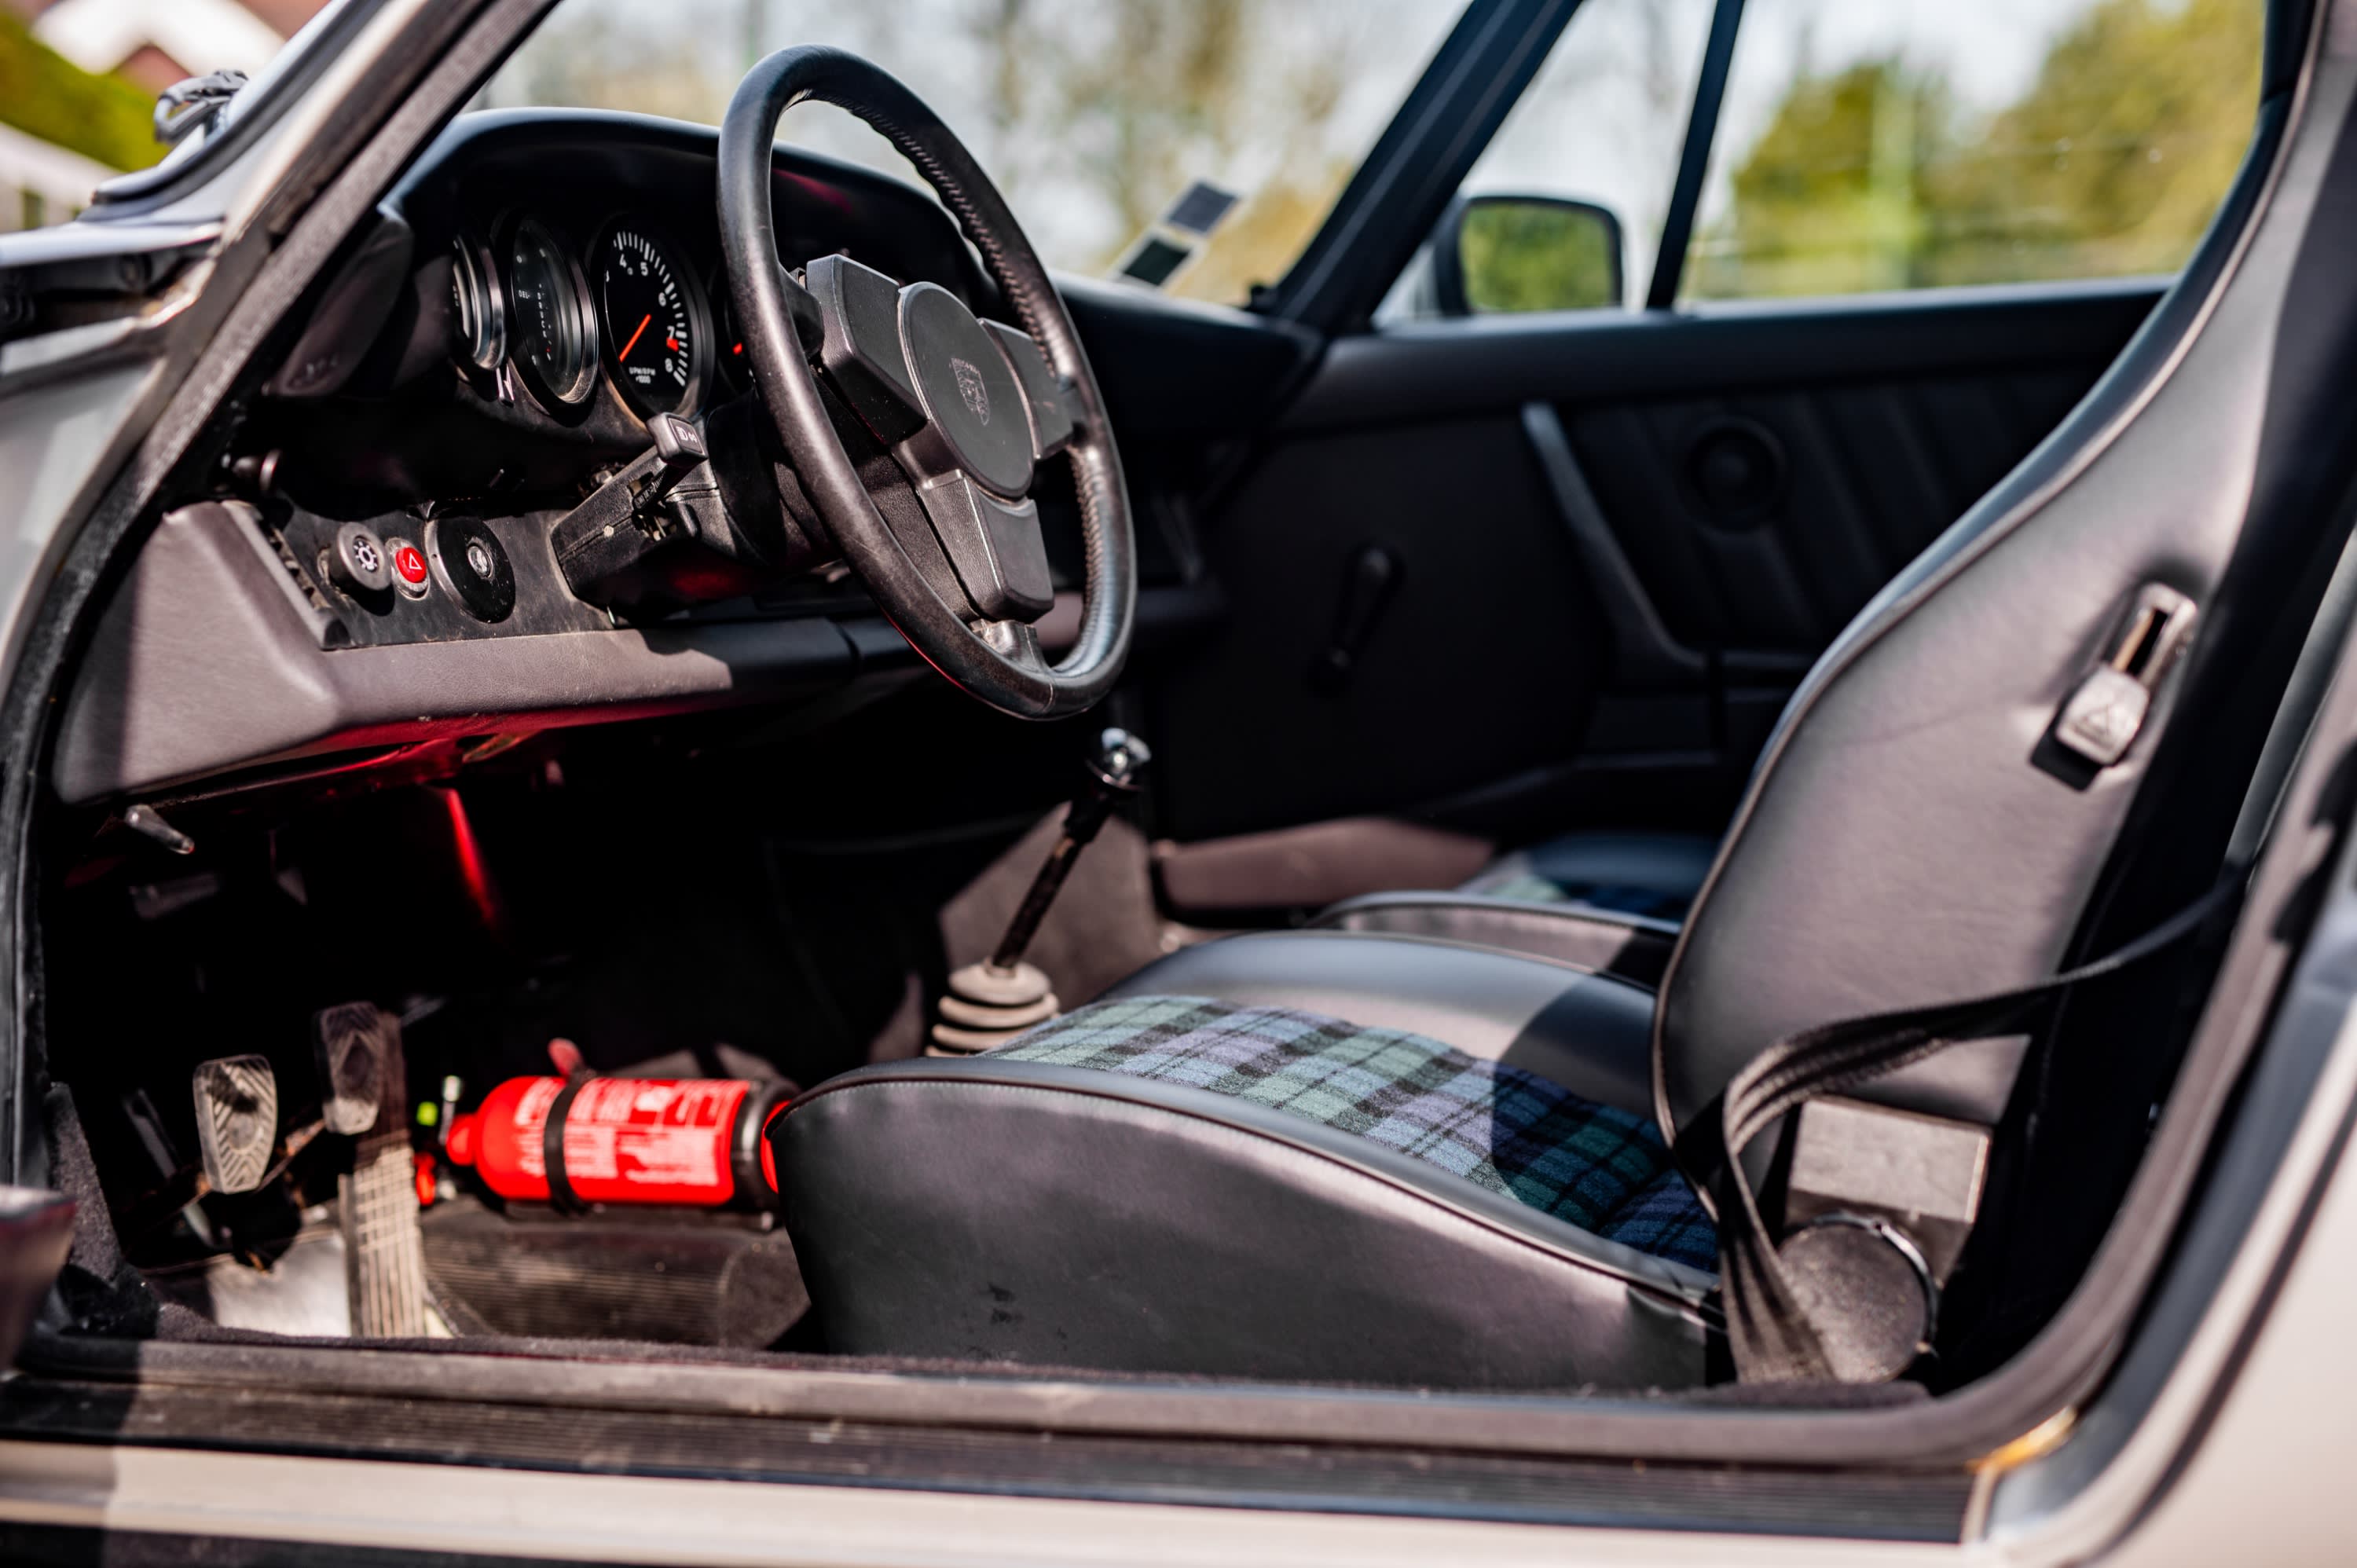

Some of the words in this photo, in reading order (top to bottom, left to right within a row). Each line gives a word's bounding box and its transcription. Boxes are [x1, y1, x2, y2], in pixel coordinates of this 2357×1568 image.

[619, 253, 627, 268] 4
[640, 261, 648, 277] 5
[658, 291, 667, 306] 6
[667, 325, 675, 339] 7
[665, 357, 673, 372] 8
